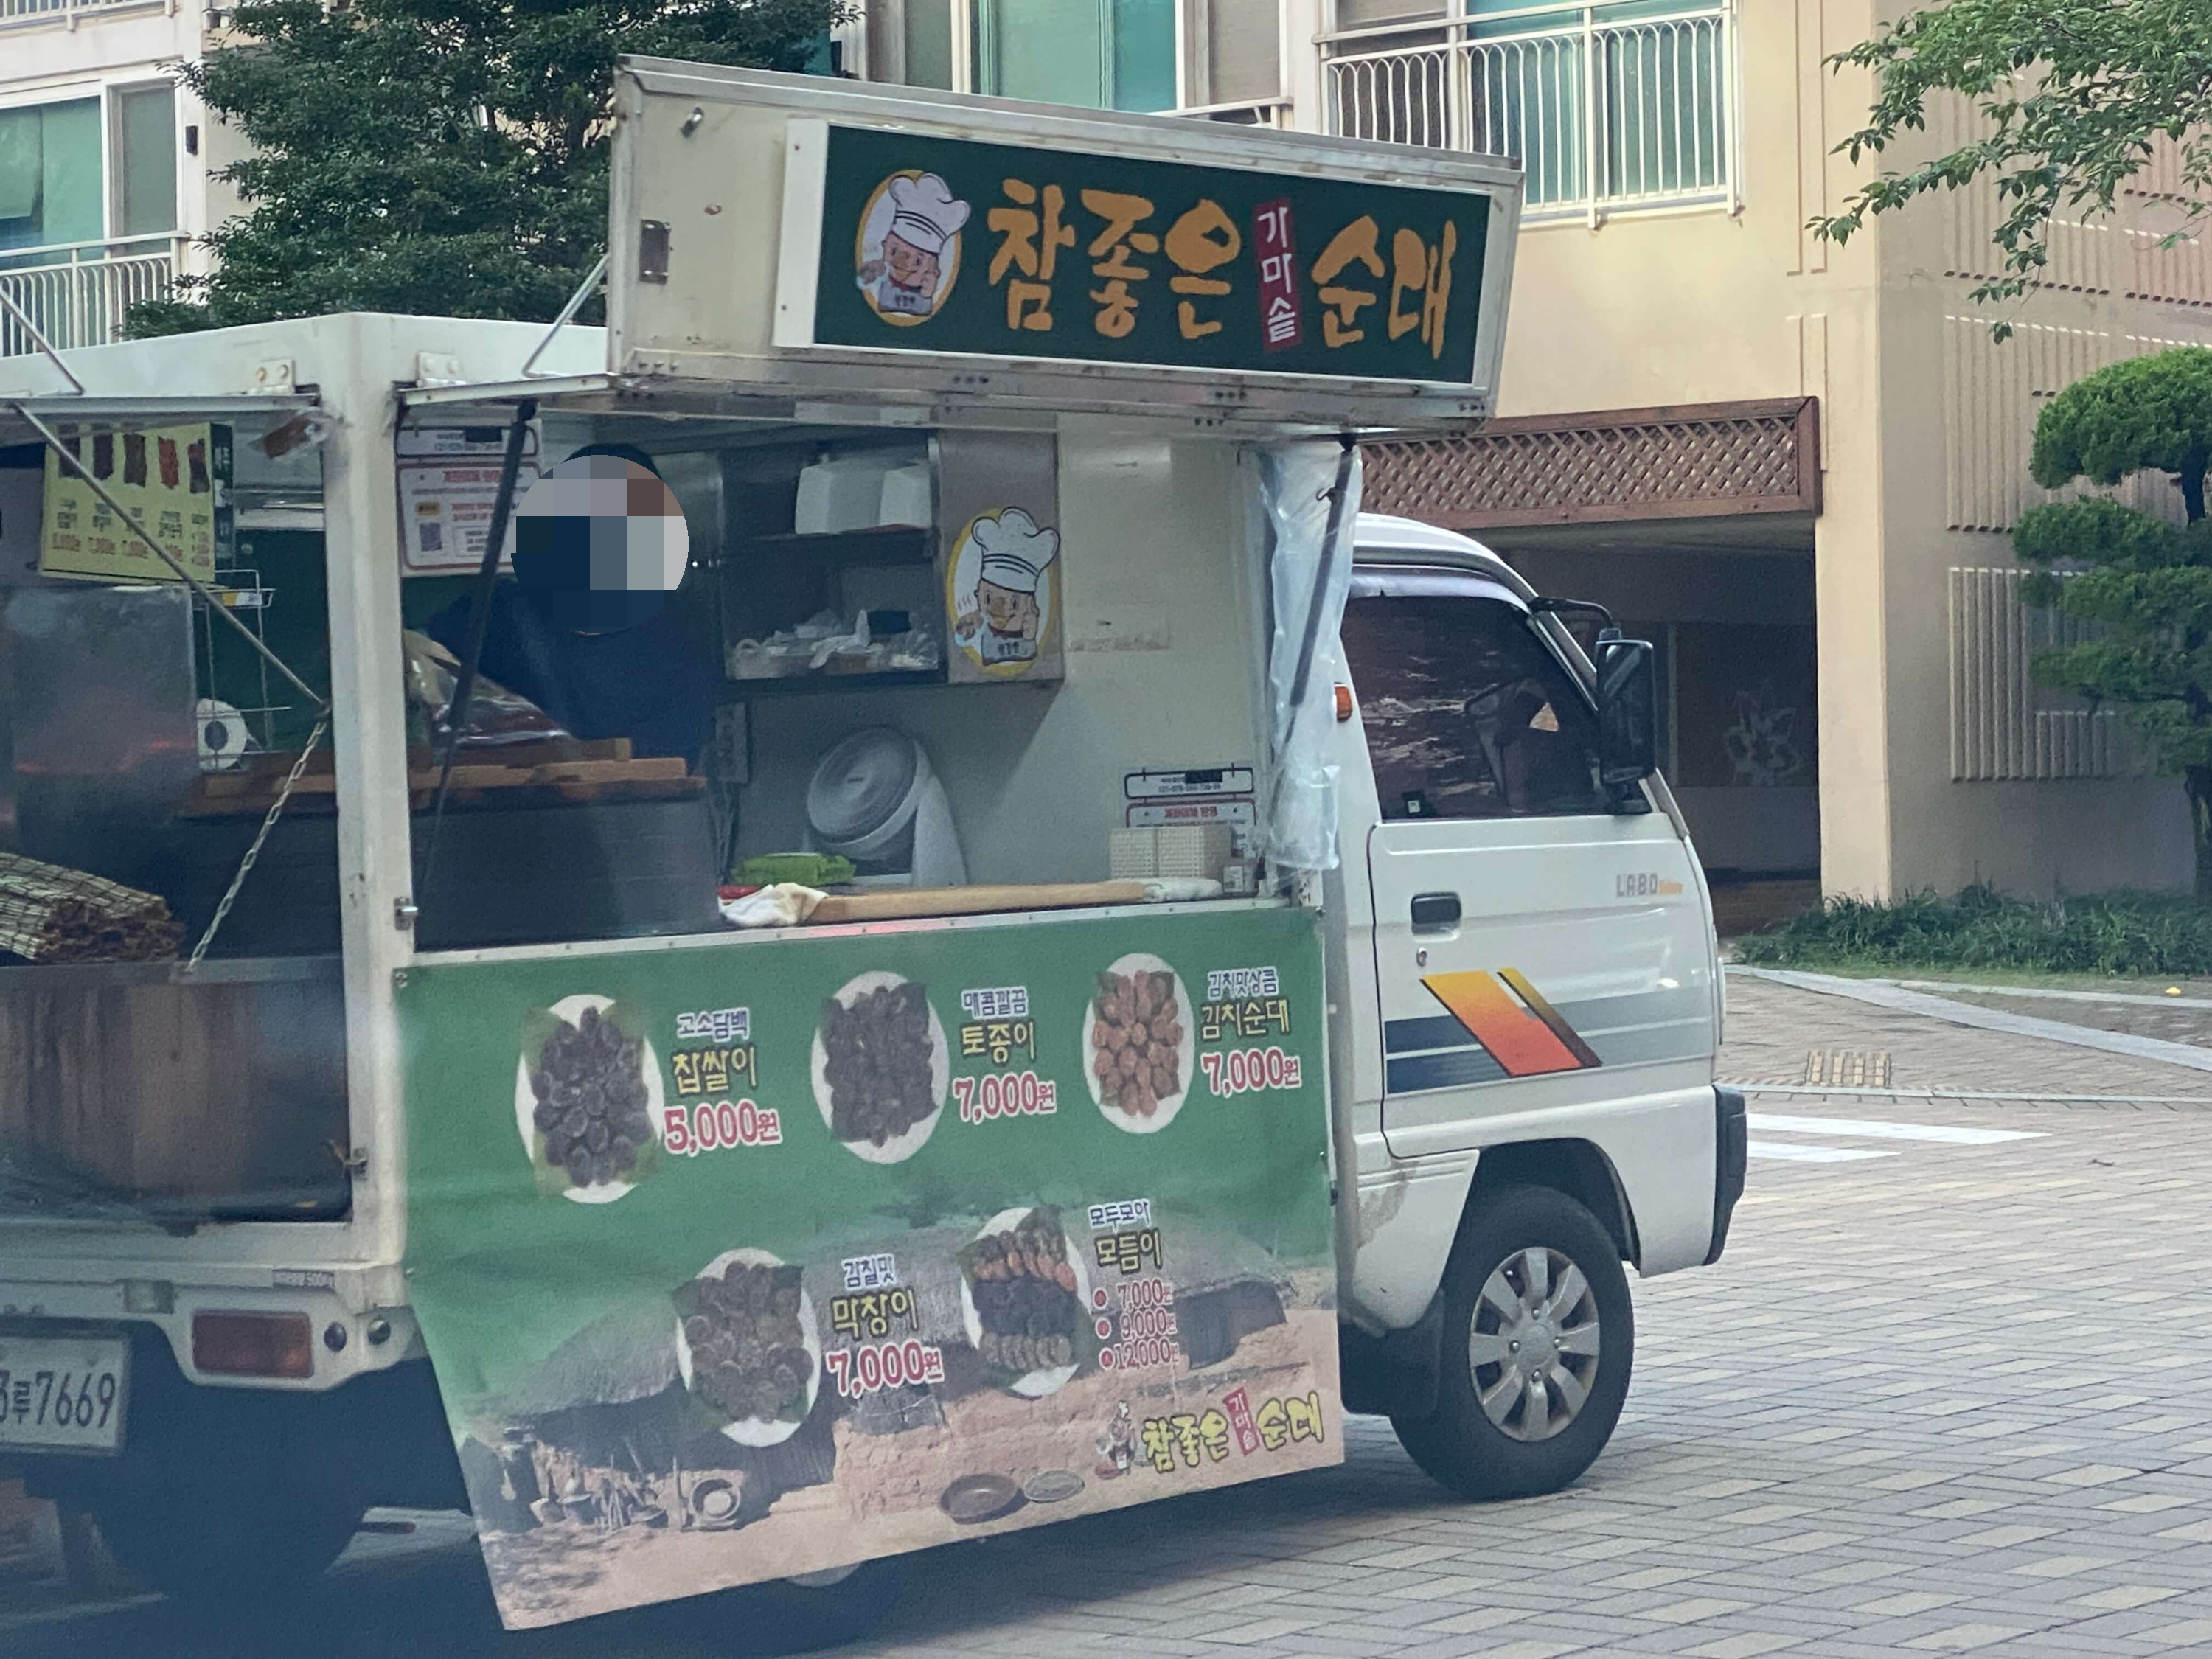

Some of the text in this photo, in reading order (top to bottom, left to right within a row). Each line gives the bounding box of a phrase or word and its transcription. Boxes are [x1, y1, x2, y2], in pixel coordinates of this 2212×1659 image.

[987, 178, 1458, 360] 참좋은 가마솥 순대
[1615, 873, 1658, 897] LABO
[1208, 967, 1278, 998] 김치맛상큼
[678, 1009, 748, 1040] 고소담백
[961, 1020, 1035, 1064] 토종이
[1201, 999, 1290, 1040] 김치순대
[672, 1046, 757, 1095] 찹쌀이
[1201, 1048, 1301, 1096] 7,000원
[953, 1072, 1056, 1123] 7,000원
[665, 1100, 781, 1155] 5,000원
[1090, 1200, 1150, 1231] 모두모아
[842, 1254, 895, 1290] 감칠맛
[1096, 1230, 1162, 1272] 모듬이
[832, 1288, 918, 1338] 막창이
[827, 1341, 944, 1398] 7,000원
[1141, 1408, 1229, 1473] 참좋은
[1256, 1390, 1324, 1452] 순대
